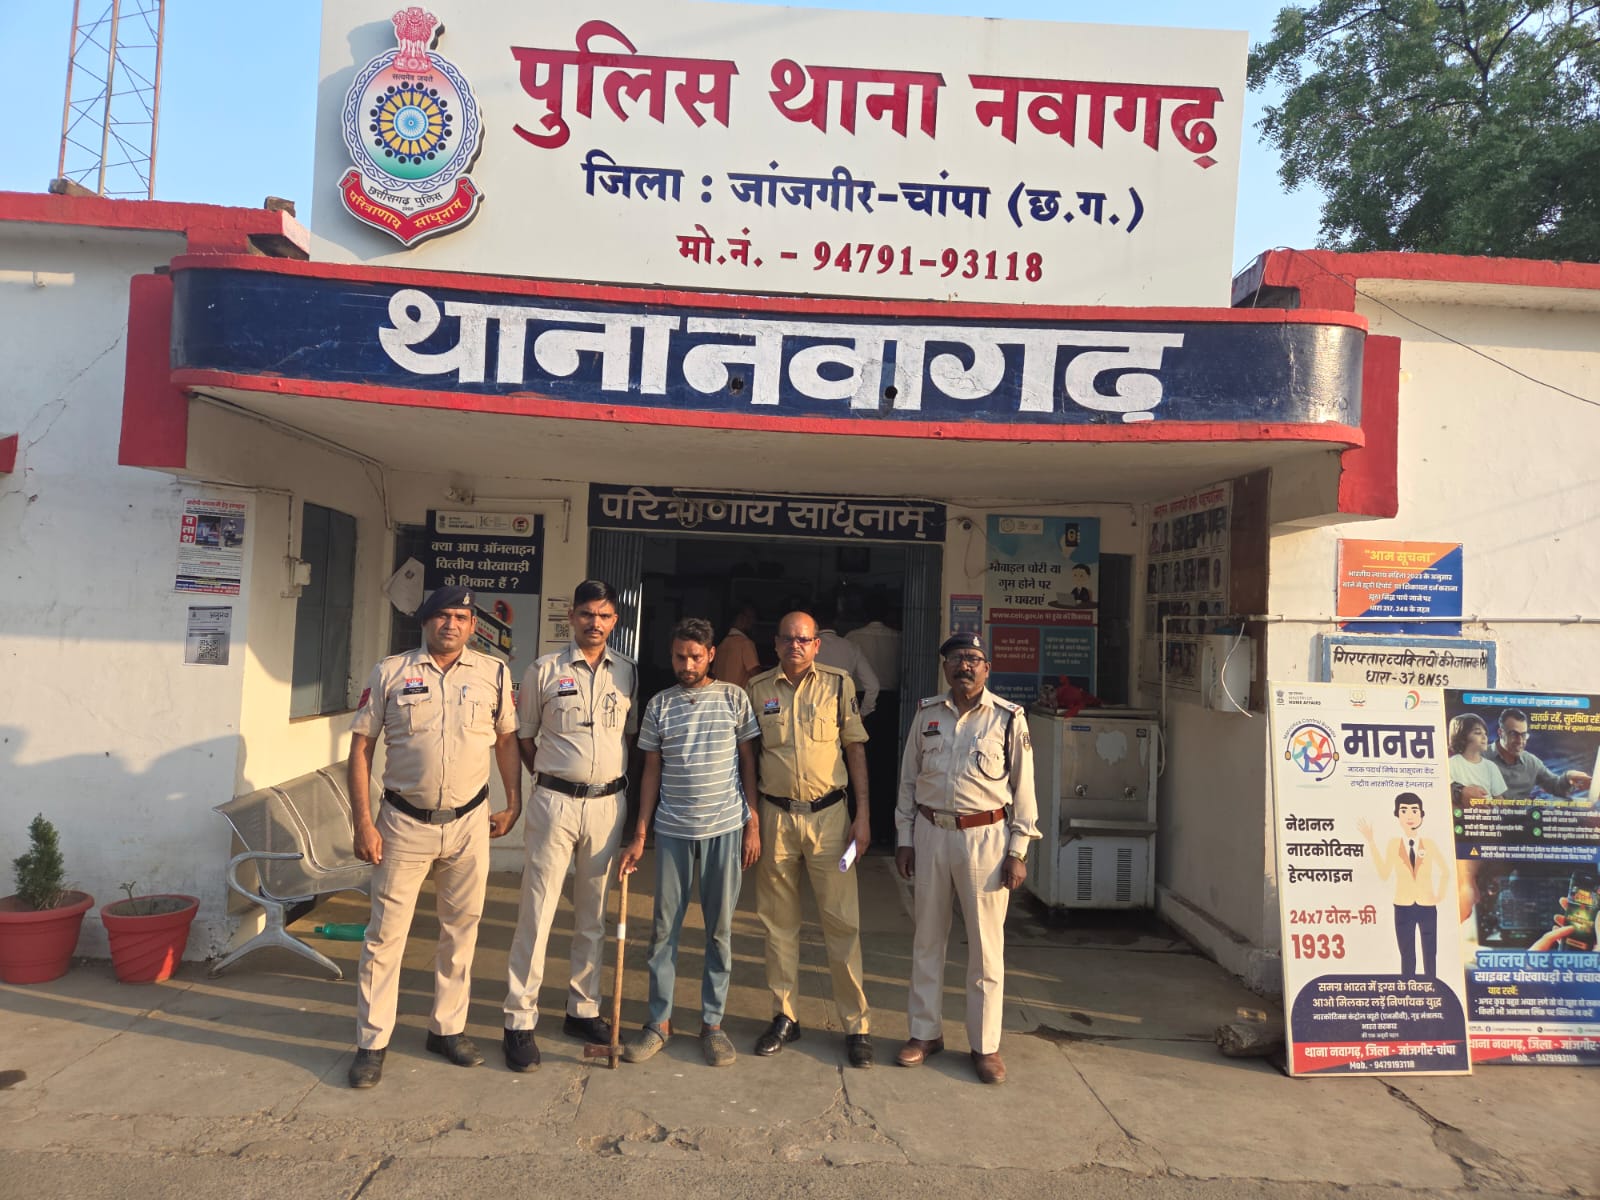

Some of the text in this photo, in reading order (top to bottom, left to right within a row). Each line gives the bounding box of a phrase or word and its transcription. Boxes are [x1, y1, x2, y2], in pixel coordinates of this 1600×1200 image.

[511, 20, 1224, 169] पुलिस थाना नवागढ़
[414, 192, 445, 207] पुलिस
[581, 149, 1144, 233] जिला जांजगीर-चांपा (छ.ग.)
[349, 190, 467, 230] परित्राणाय साधूनाम्
[677, 224, 1043, 282] मो.नं. 94791-93118
[378, 289, 680, 395] थाना
[787, 499, 935, 538] साधूनाम्
[431, 541, 536, 557] क्या आप ऑनलाइन
[435, 556, 530, 573] वित्तीय धोखाधड़ी
[1027, 561, 1047, 574] चोरी
[1050, 564, 1061, 574] या
[458, 574, 496, 588] शिकार
[498, 576, 508, 589] हैं
[998, 577, 1052, 591] गुम होने पर
[1004, 593, 1045, 606] न घबराएं
[1333, 646, 1386, 666] गिरफ्तार
[1365, 670, 1450, 687] धारा 37 BNSS
[1530, 711, 1549, 722] सतर्क
[1564, 712, 1589, 725] सुरक्षित
[1341, 723, 1435, 759] मानस
[1285, 814, 1335, 832] नेशनल
[1286, 839, 1364, 857] नारकोटिक्स
[1288, 864, 1353, 884] हेल्पलाइन
[1290, 905, 1377, 925] 24x7 टोल-फ्री
[1291, 933, 1345, 959] 1933
[1477, 952, 1527, 968] लालच
[1528, 952, 1549, 968] पर
[1474, 971, 1511, 982] साइबर
[1513, 969, 1560, 984] धोखाधड़ी
[1562, 970, 1573, 982] से
[1318, 982, 1343, 992] समग्र
[1344, 982, 1367, 992] भारत
[1369, 980, 1377, 992] में
[1397, 980, 1406, 992] के
[1312, 996, 1334, 1007] आओ
[1336, 996, 1370, 1008] मिलकर
[1387, 995, 1424, 1008] निर्णायक
[1425, 997, 1442, 1009] युद्ध
[1305, 1047, 1328, 1057] थाना
[1365, 1044, 1389, 1057] जिला
[1398, 1044, 1456, 1057] जांजगीर-चांपा
[1527, 1036, 1552, 1049] जिला
[1349, 1061, 1367, 1070] Mob.
